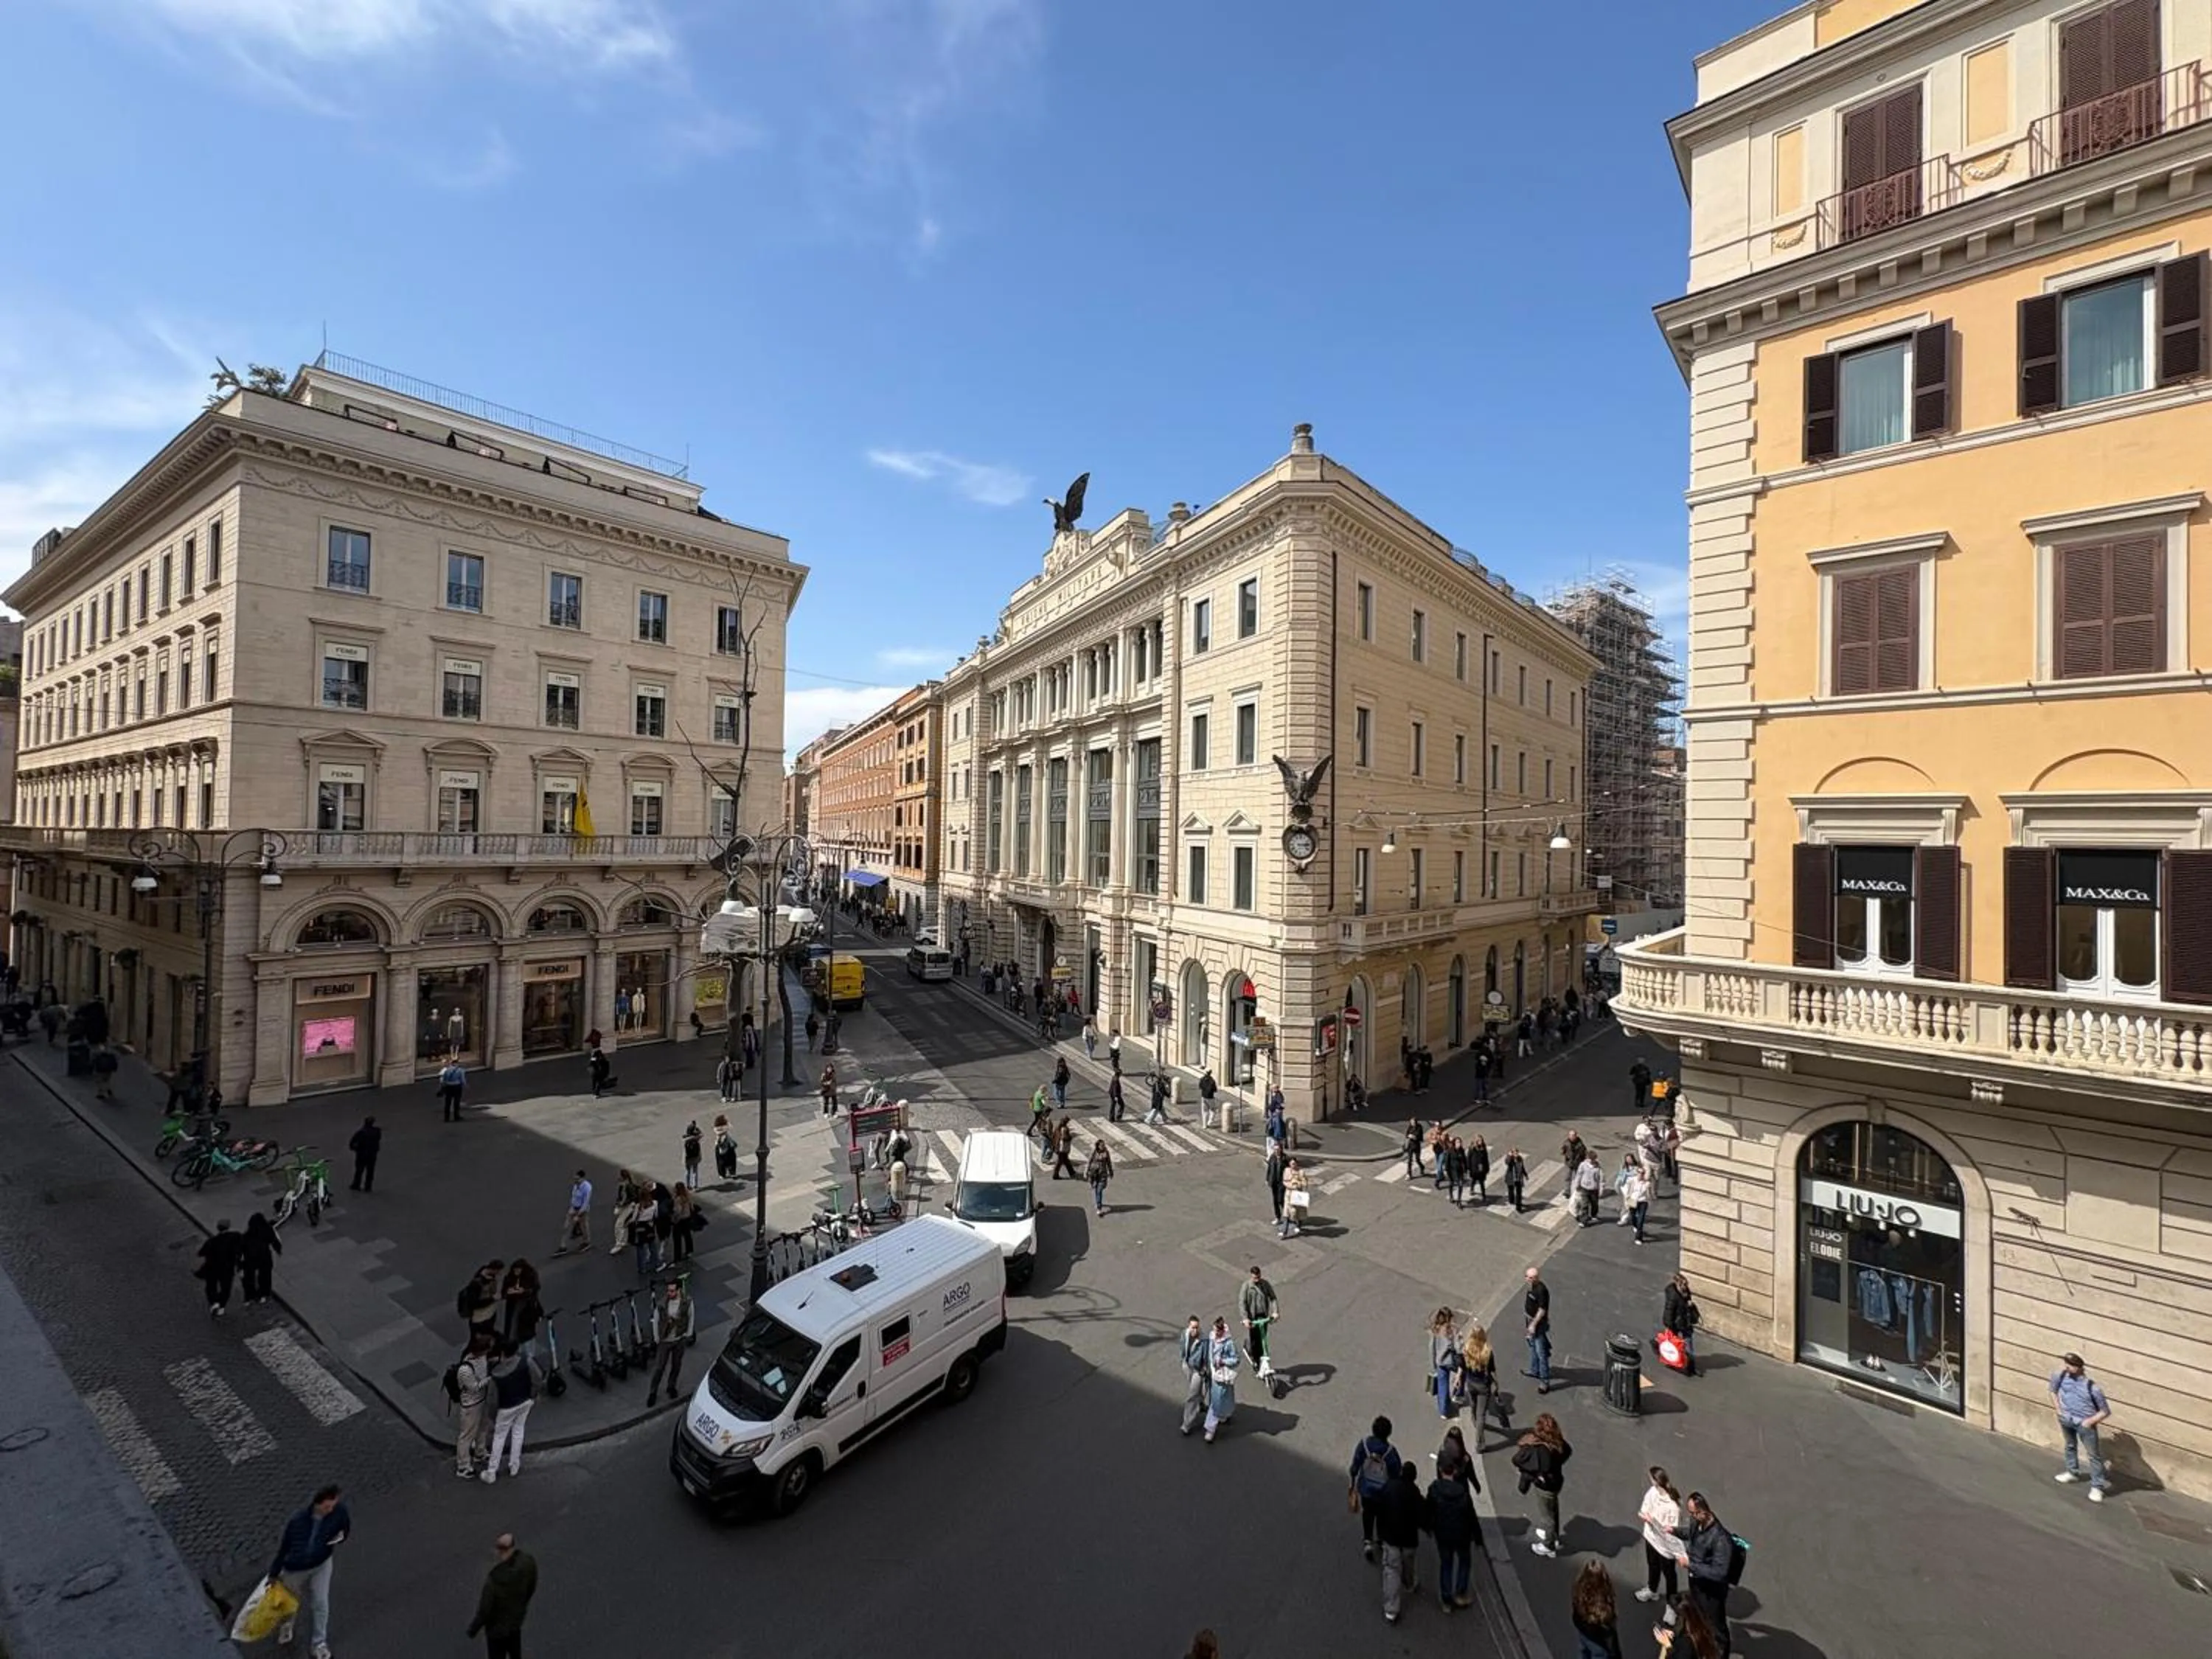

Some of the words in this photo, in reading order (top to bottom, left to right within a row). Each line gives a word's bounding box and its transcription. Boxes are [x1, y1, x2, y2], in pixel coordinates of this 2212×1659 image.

[538, 964, 569, 975] FENDI
[313, 983, 355, 996] FENDI
[1810, 1242, 1843, 1261] ELODIE
[944, 1281, 970, 1308] ARGO
[696, 1412, 720, 1438] ARGO
